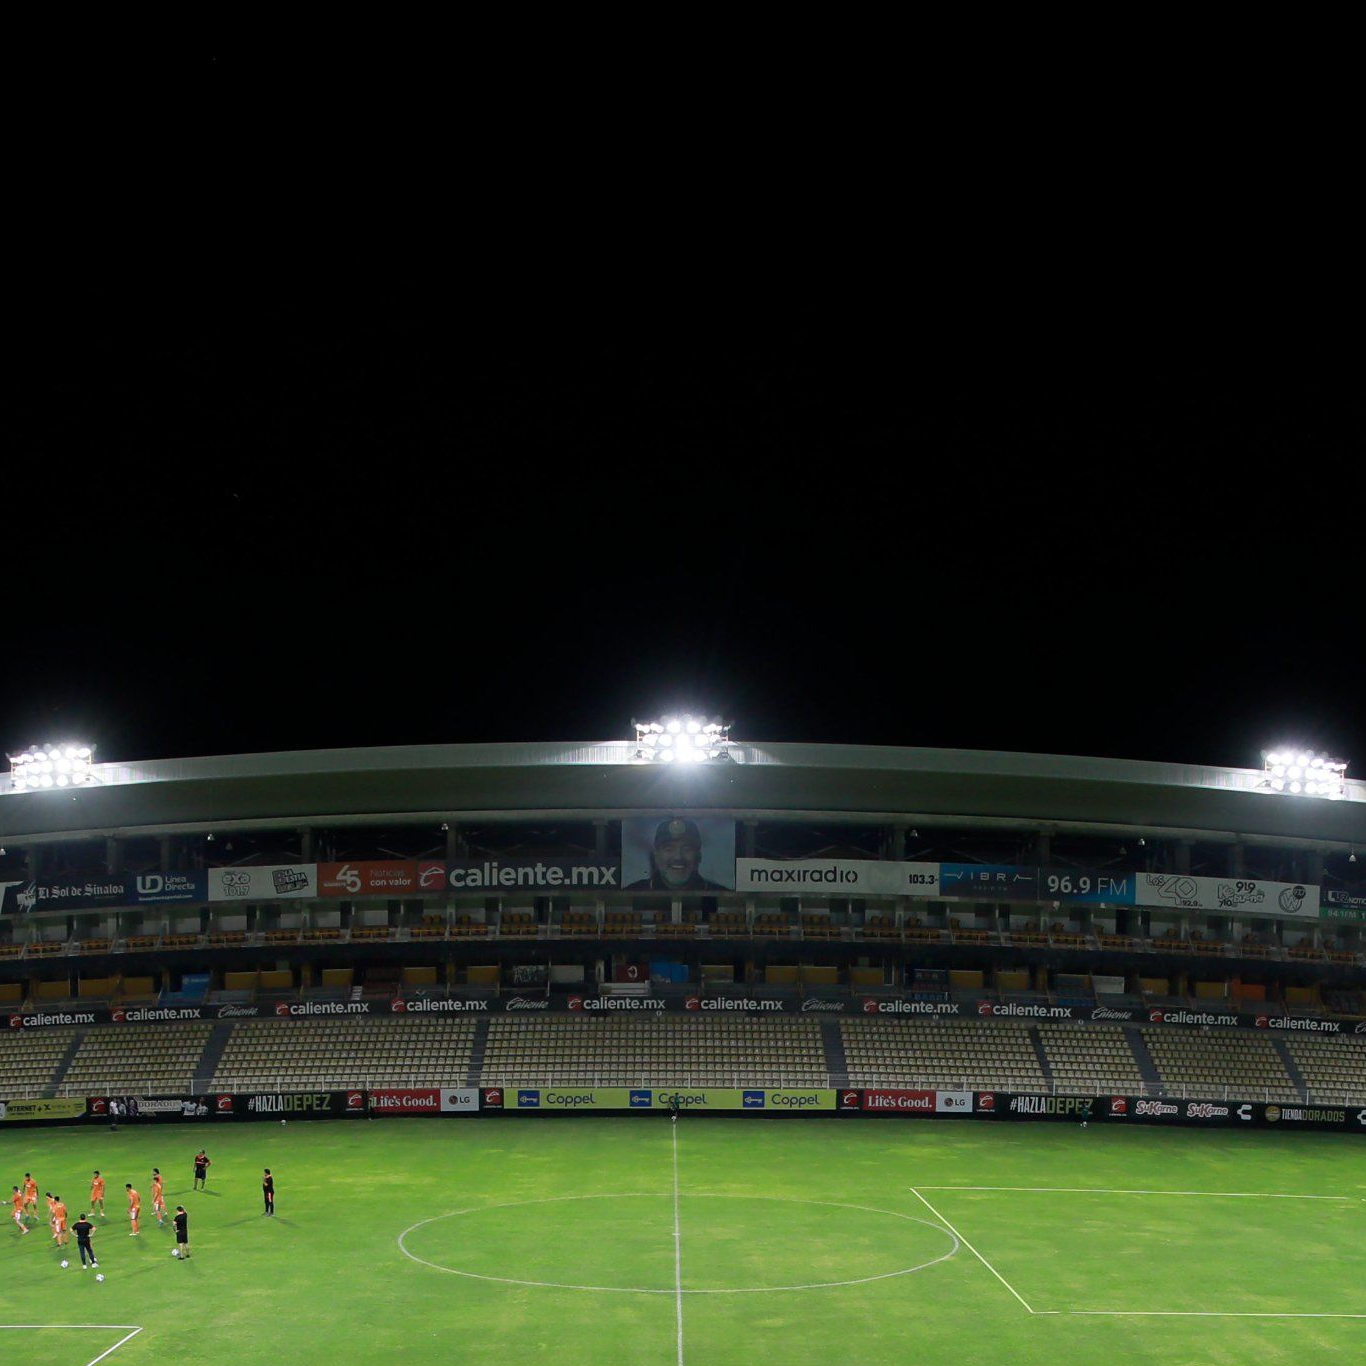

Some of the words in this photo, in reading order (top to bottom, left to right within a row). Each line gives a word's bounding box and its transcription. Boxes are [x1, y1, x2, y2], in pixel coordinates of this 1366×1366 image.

[449, 862, 617, 887] caliente.mx
[750, 866, 858, 883] maxiradio
[52, 885, 69, 898] Sol
[71, 885, 82, 896] de
[84, 882, 124, 896] Sinaloa
[1047, 875, 1091, 894] 96.9
[1097, 878, 1126, 895] FM
[290, 1001, 369, 1015] caliente.mx
[407, 998, 488, 1012] caliente.mx
[584, 996, 666, 1010] caliente.mx
[701, 997, 783, 1011] caliente.mx
[878, 999, 959, 1014] caliente.mx
[126, 1007, 200, 1021] caliente.mx
[993, 1003, 1072, 1018] caliente.mx
[23, 1012, 95, 1027] caliente.mx
[1163, 1011, 1239, 1026] caliente.mx
[1268, 1017, 1340, 1032] caliente.mx
[374, 1095, 401, 1108] Life's
[402, 1094, 437, 1108] Good.
[459, 1096, 470, 1104] LG
[546, 1093, 596, 1107] Coppel
[771, 1094, 820, 1107] Coppel
[868, 1096, 896, 1107] Life's
[898, 1096, 933, 1108] Good.
[1135, 1101, 1178, 1115] SuKarne
[1187, 1103, 1228, 1117] SuKarne
